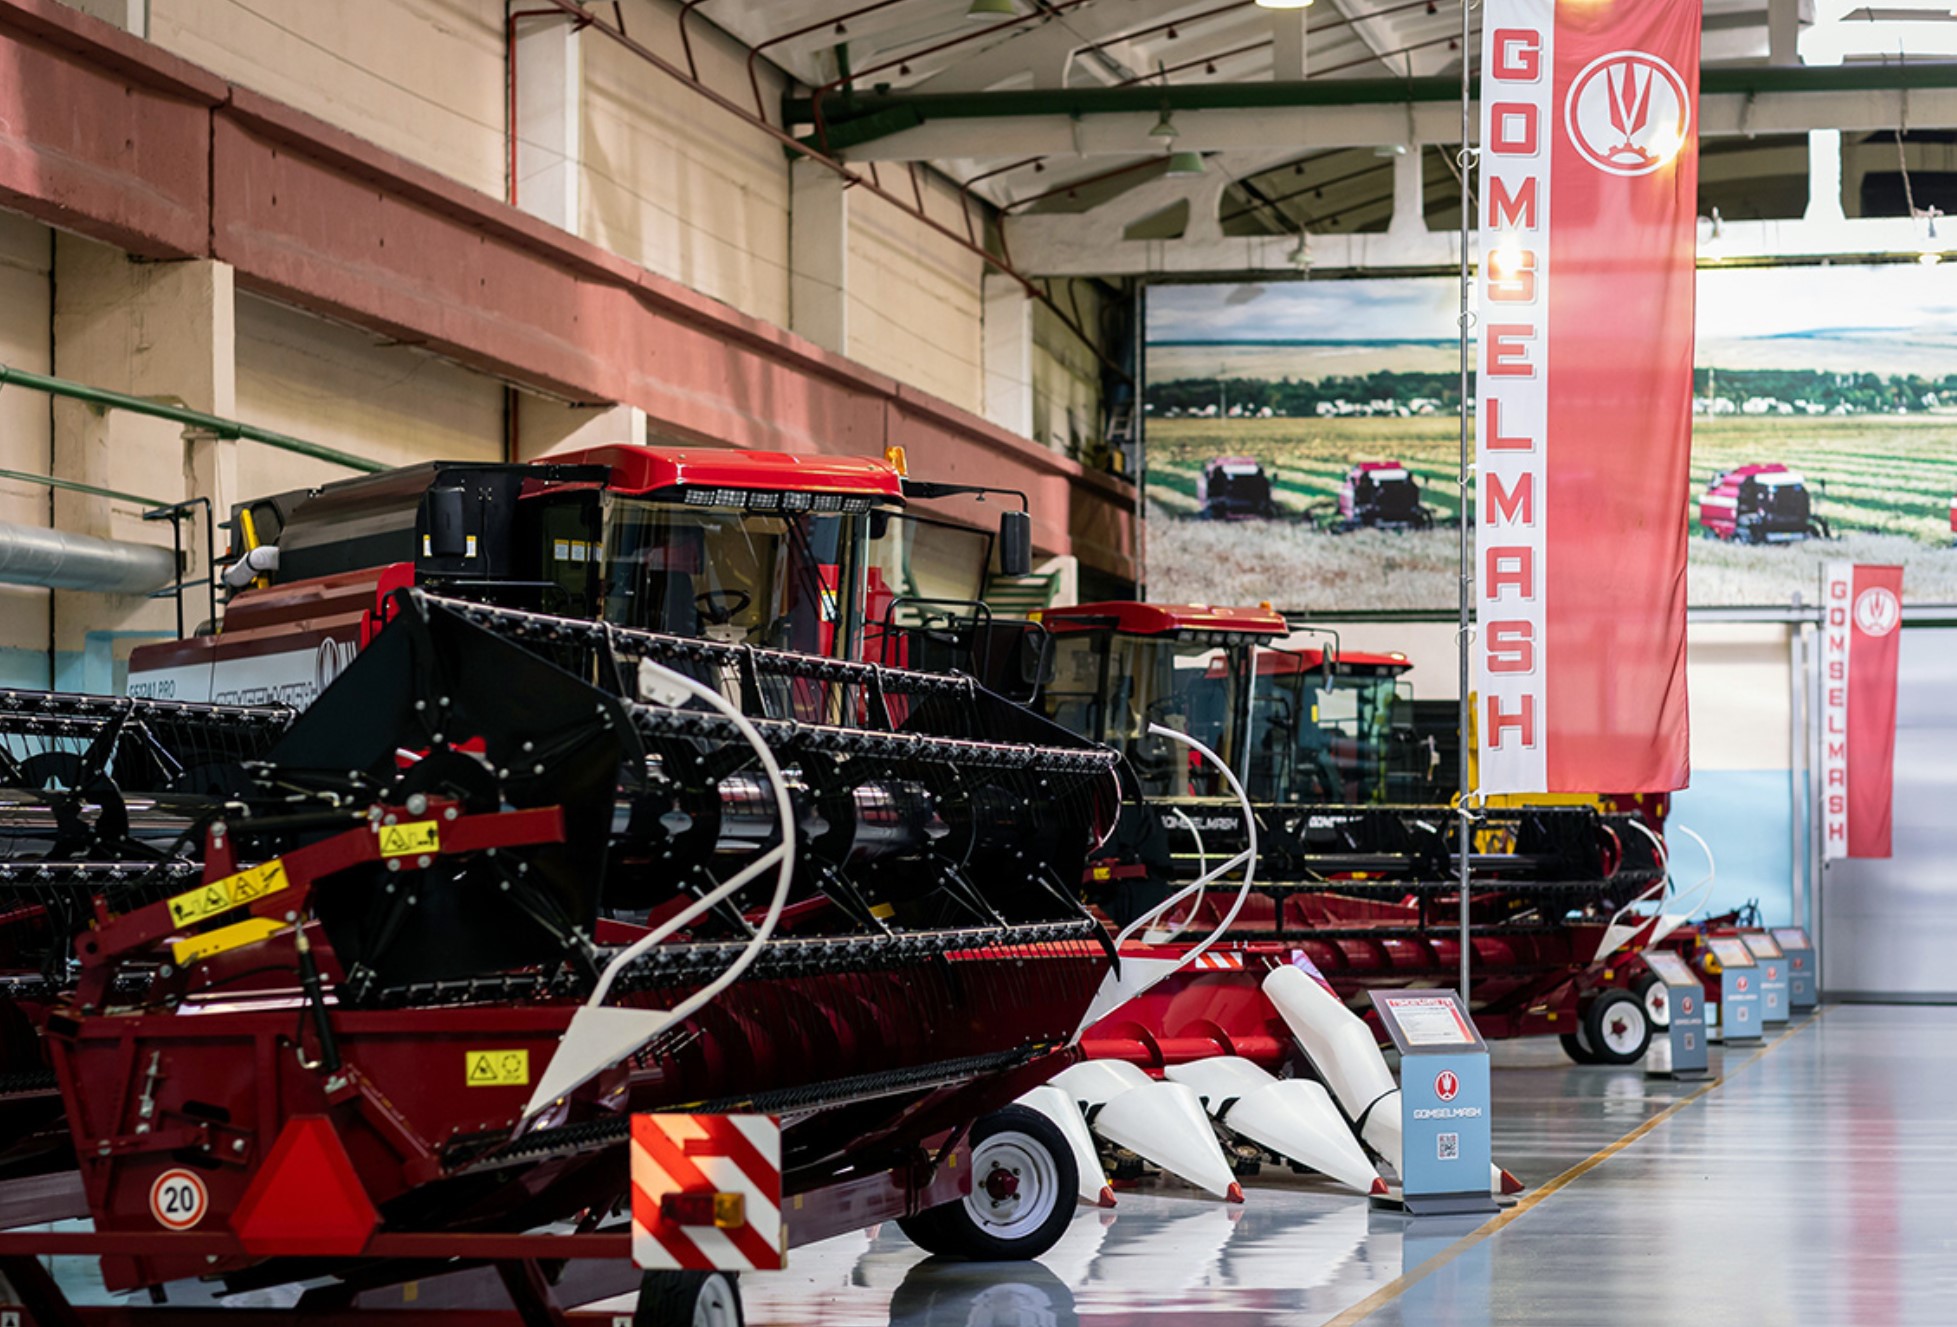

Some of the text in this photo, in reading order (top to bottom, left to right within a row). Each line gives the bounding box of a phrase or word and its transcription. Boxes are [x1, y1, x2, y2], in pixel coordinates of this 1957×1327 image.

[1486, 28, 1543, 749] GOMSELMASH
[158, 679, 176, 699] PRO
[1828, 580, 1848, 841] GOMSELMASH
[1413, 1107, 1482, 1119] GOMSELMASH
[164, 1185, 195, 1213] 20
